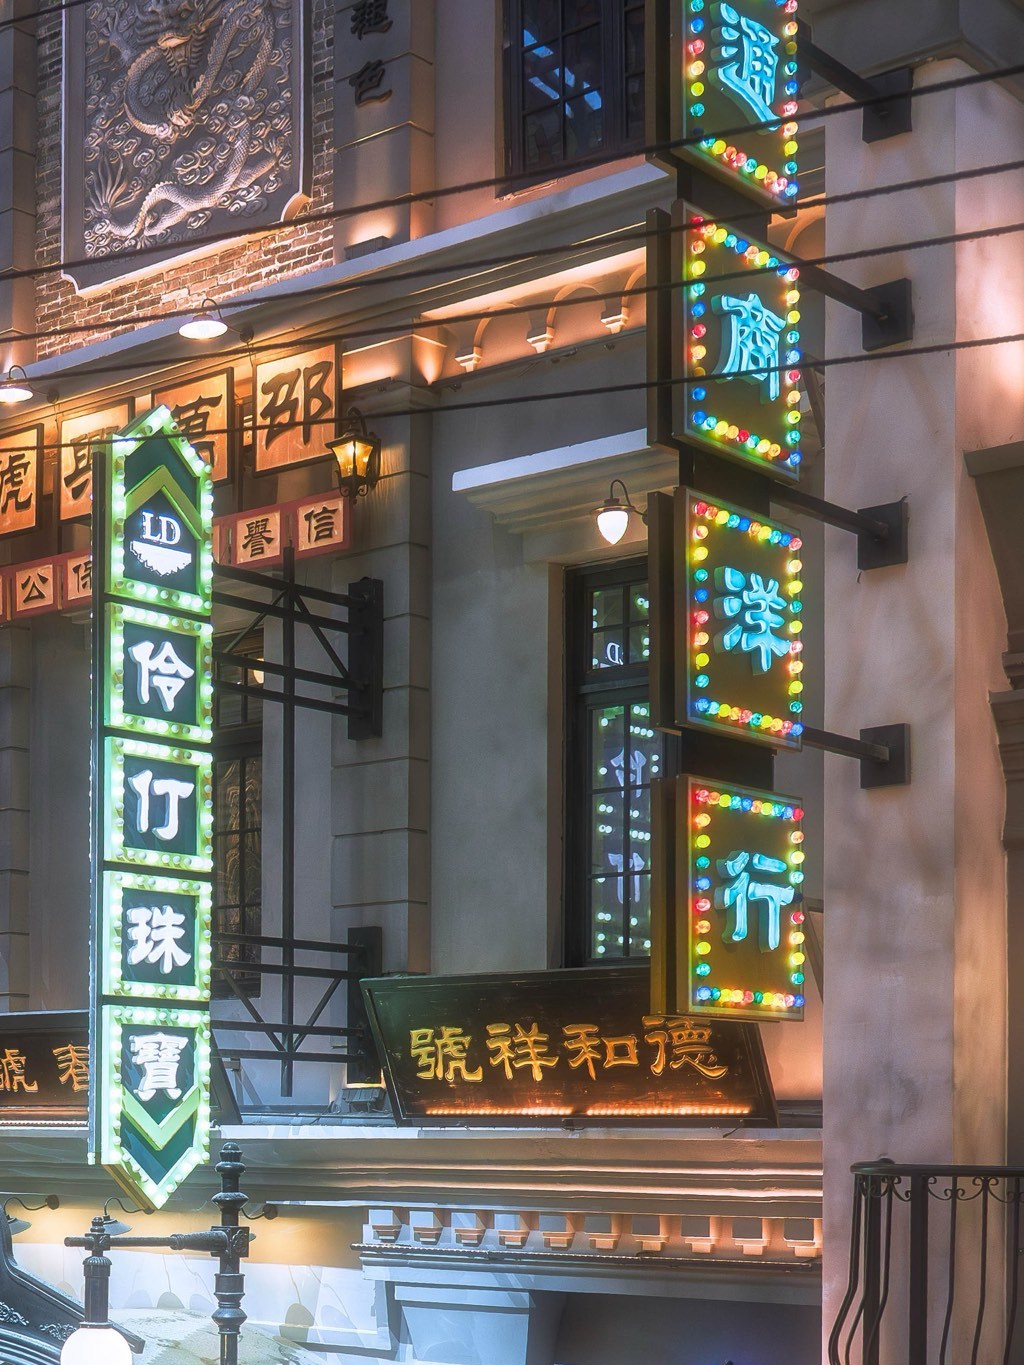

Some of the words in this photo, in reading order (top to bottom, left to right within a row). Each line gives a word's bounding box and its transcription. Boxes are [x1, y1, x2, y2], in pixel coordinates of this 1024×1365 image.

[141, 511, 181, 545] LD
[709, 2, 795, 952] 通商洋行
[127, 640, 195, 1101] 伶仃珠寶
